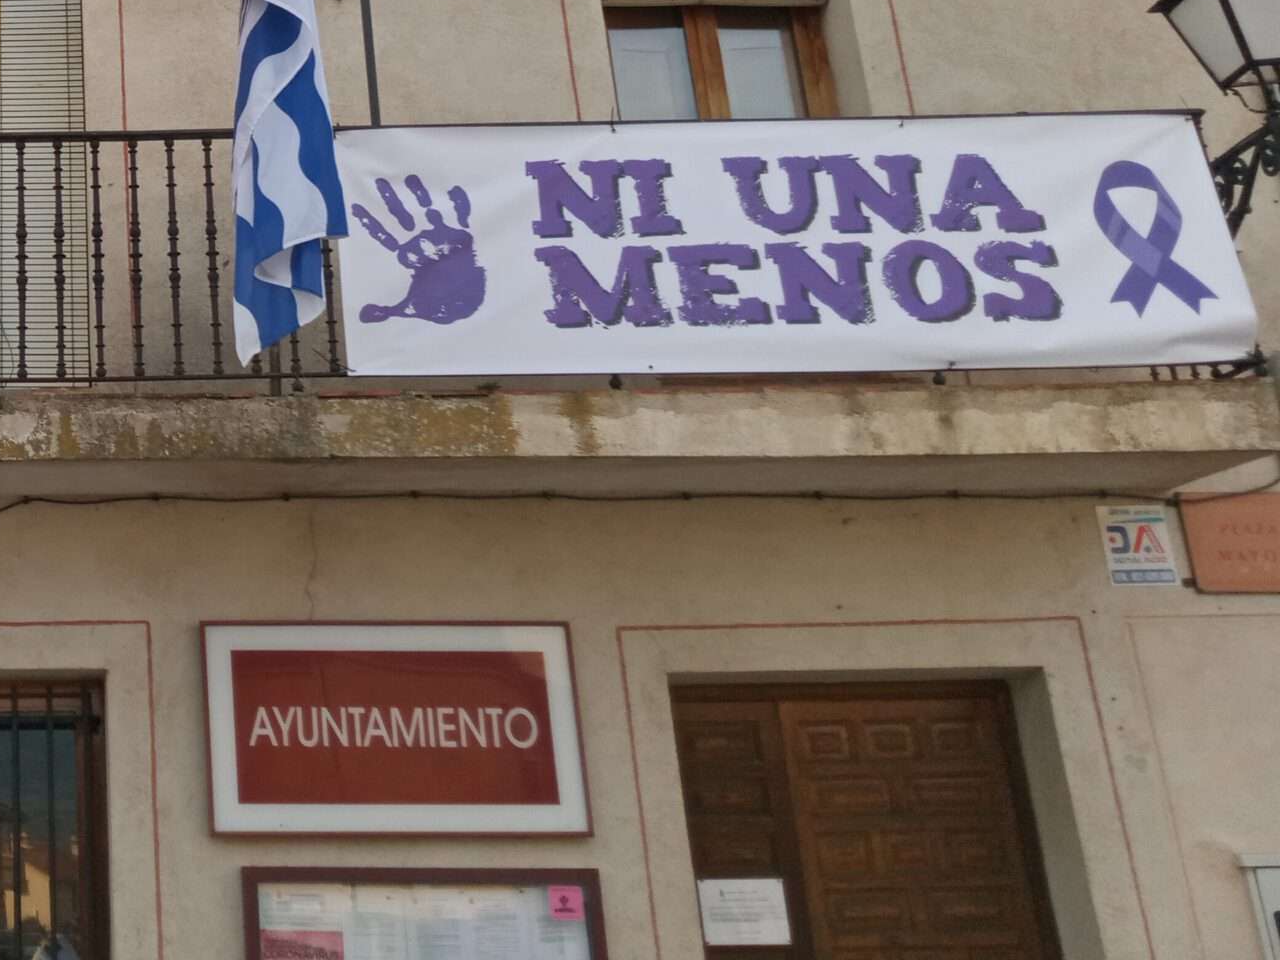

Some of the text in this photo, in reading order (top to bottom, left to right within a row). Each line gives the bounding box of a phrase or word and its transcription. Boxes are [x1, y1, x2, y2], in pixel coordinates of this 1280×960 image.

[526, 153, 1048, 238] NI UNA
[534, 241, 1062, 328] MENOS
[249, 706, 539, 749] AYUNTAMIENTO
